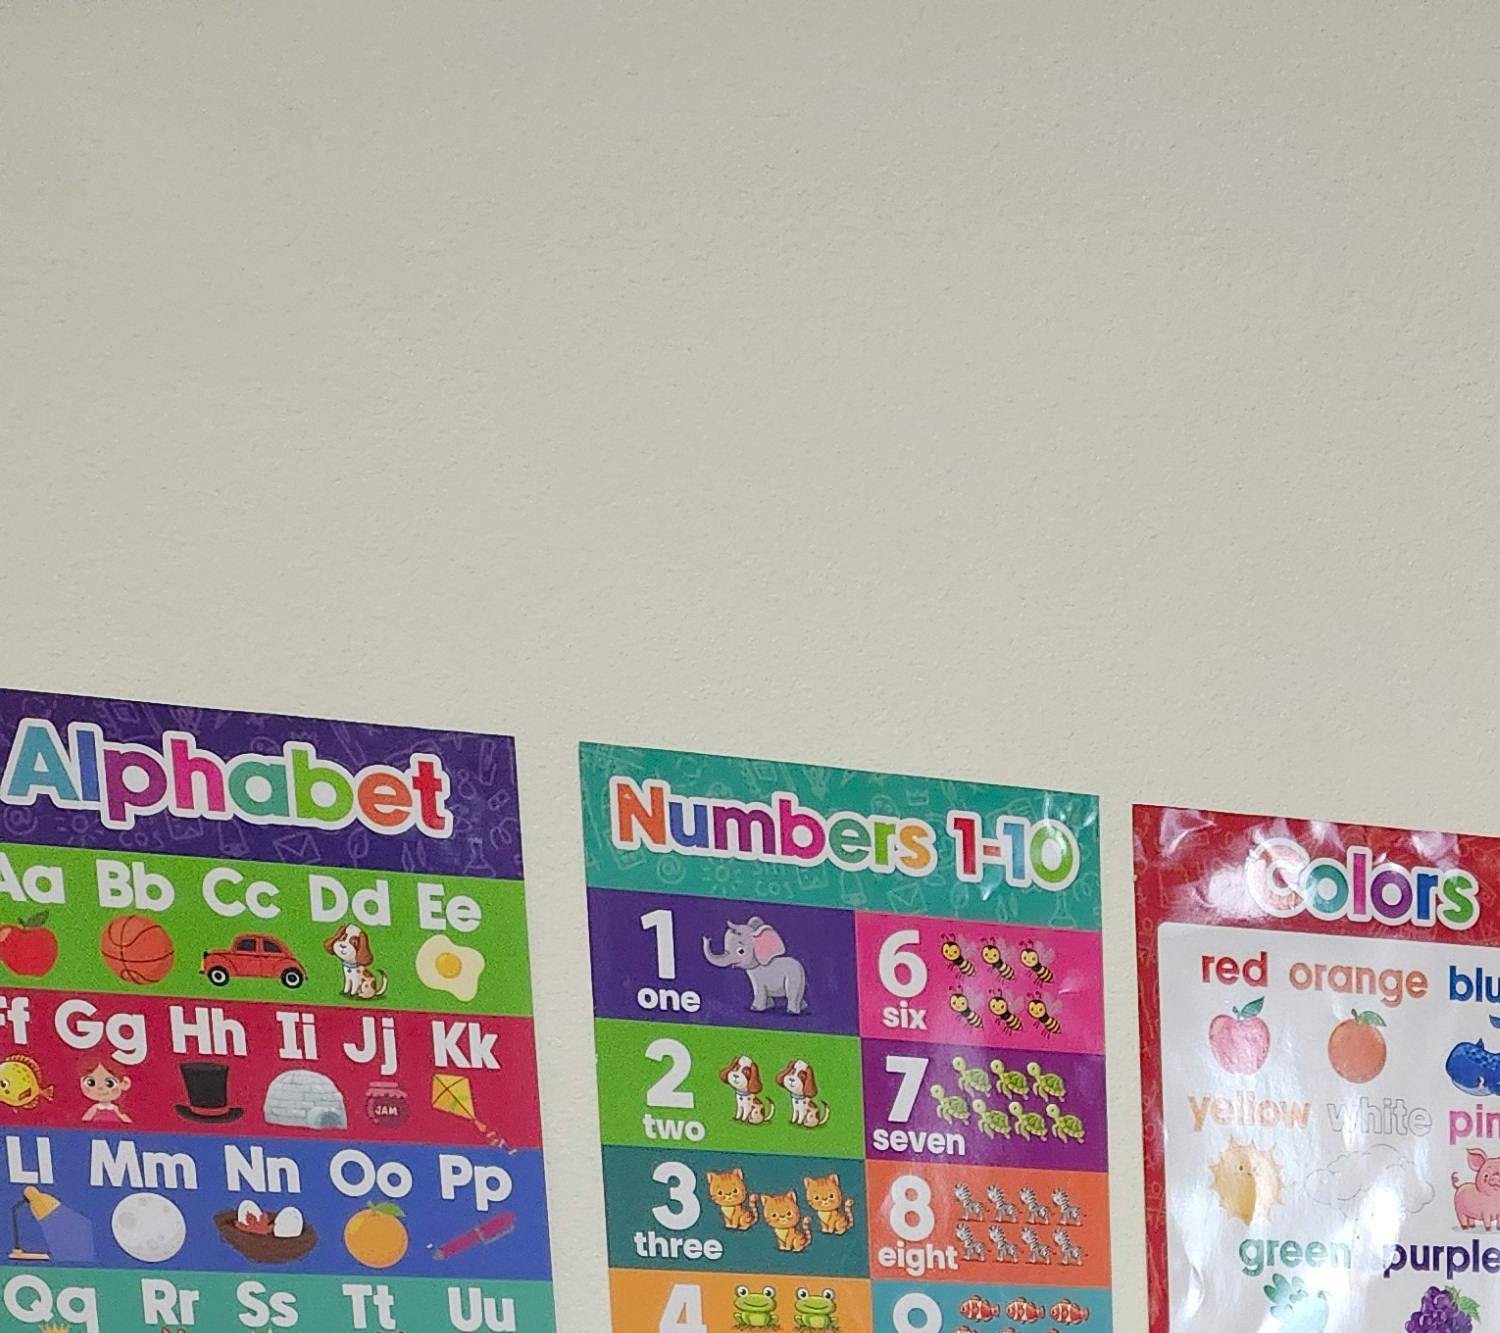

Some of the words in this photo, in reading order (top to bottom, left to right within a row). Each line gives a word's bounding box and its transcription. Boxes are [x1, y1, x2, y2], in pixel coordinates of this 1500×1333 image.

[3, 719, 452, 838] Alphabet
[609, 775, 937, 874] Numbers
[948, 810, 1079, 891] 1-10
[95, 859, 175, 911] Bb
[202, 867, 281, 919] Cc
[309, 874, 391, 932] Dd
[417, 882, 482, 932] Ee
[1247, 837, 1481, 931] Colors
[640, 909, 676, 979] 1
[878, 929, 928, 998] 6
[637, 987, 701, 1013] one
[1201, 951, 1268, 987] red
[1288, 961, 1429, 1008] orange
[0, 996, 30, 1045] f
[54, 999, 148, 1065] Gg
[169, 1005, 247, 1056] Hh
[276, 1011, 317, 1060] Ii
[343, 1016, 398, 1075] Jj
[431, 1020, 500, 1069] Kk
[883, 1000, 927, 1030] six
[645, 1038, 694, 1109] 2
[885, 1055, 934, 1122] 7
[375, 1105, 399, 1116] JAM
[642, 1113, 705, 1142] two
[873, 1128, 966, 1156] seven
[1187, 1090, 1313, 1132] yellow
[1325, 1097, 1433, 1136] white
[5, 1135, 54, 1184] Ll
[90, 1139, 198, 1195] Mm
[224, 1144, 301, 1193] Nn
[329, 1149, 413, 1198] Oo
[438, 1154, 513, 1212] Pp
[651, 1161, 700, 1230] 3
[889, 1175, 935, 1241] 8
[633, 1227, 723, 1260] three
[877, 1237, 959, 1277] eight
[1238, 1237, 1352, 1276] green
[3, 1274, 100, 1333] Qq
[141, 1278, 200, 1325] Rr
[236, 1280, 299, 1327] Ss
[342, 1283, 396, 1330] Tt
